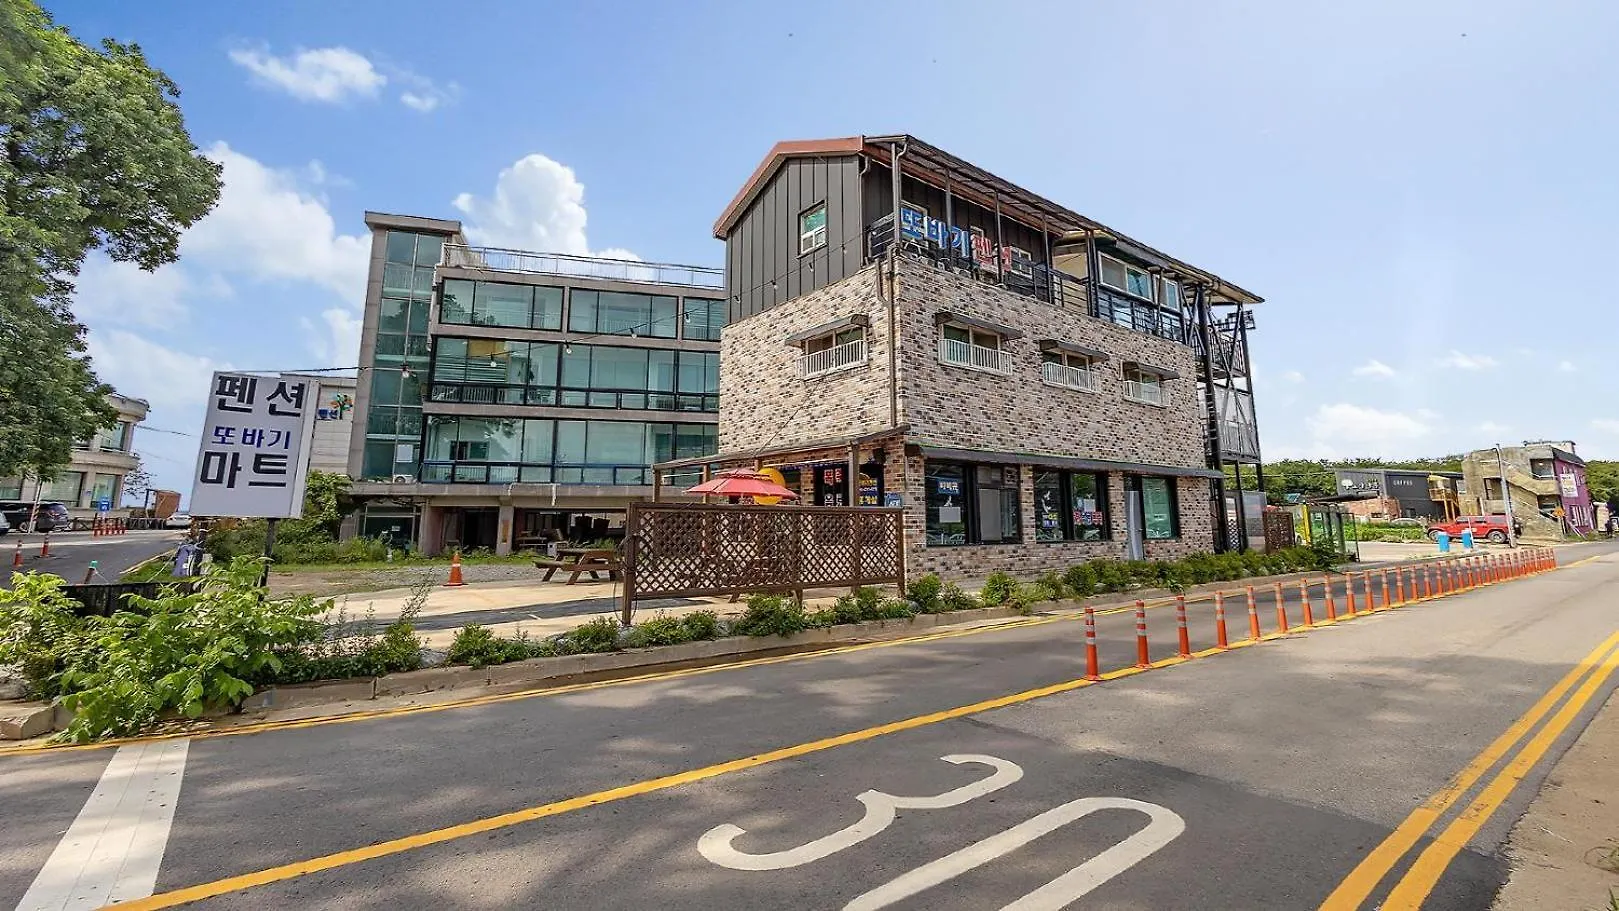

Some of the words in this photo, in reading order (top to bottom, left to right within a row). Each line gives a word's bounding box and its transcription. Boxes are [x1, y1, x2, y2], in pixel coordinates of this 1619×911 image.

[901, 207, 969, 258] 또바기
[215, 375, 305, 417] 펜션
[211, 425, 291, 449] 또바기
[200, 451, 288, 488] 마트
[697, 754, 1185, 911] 30
